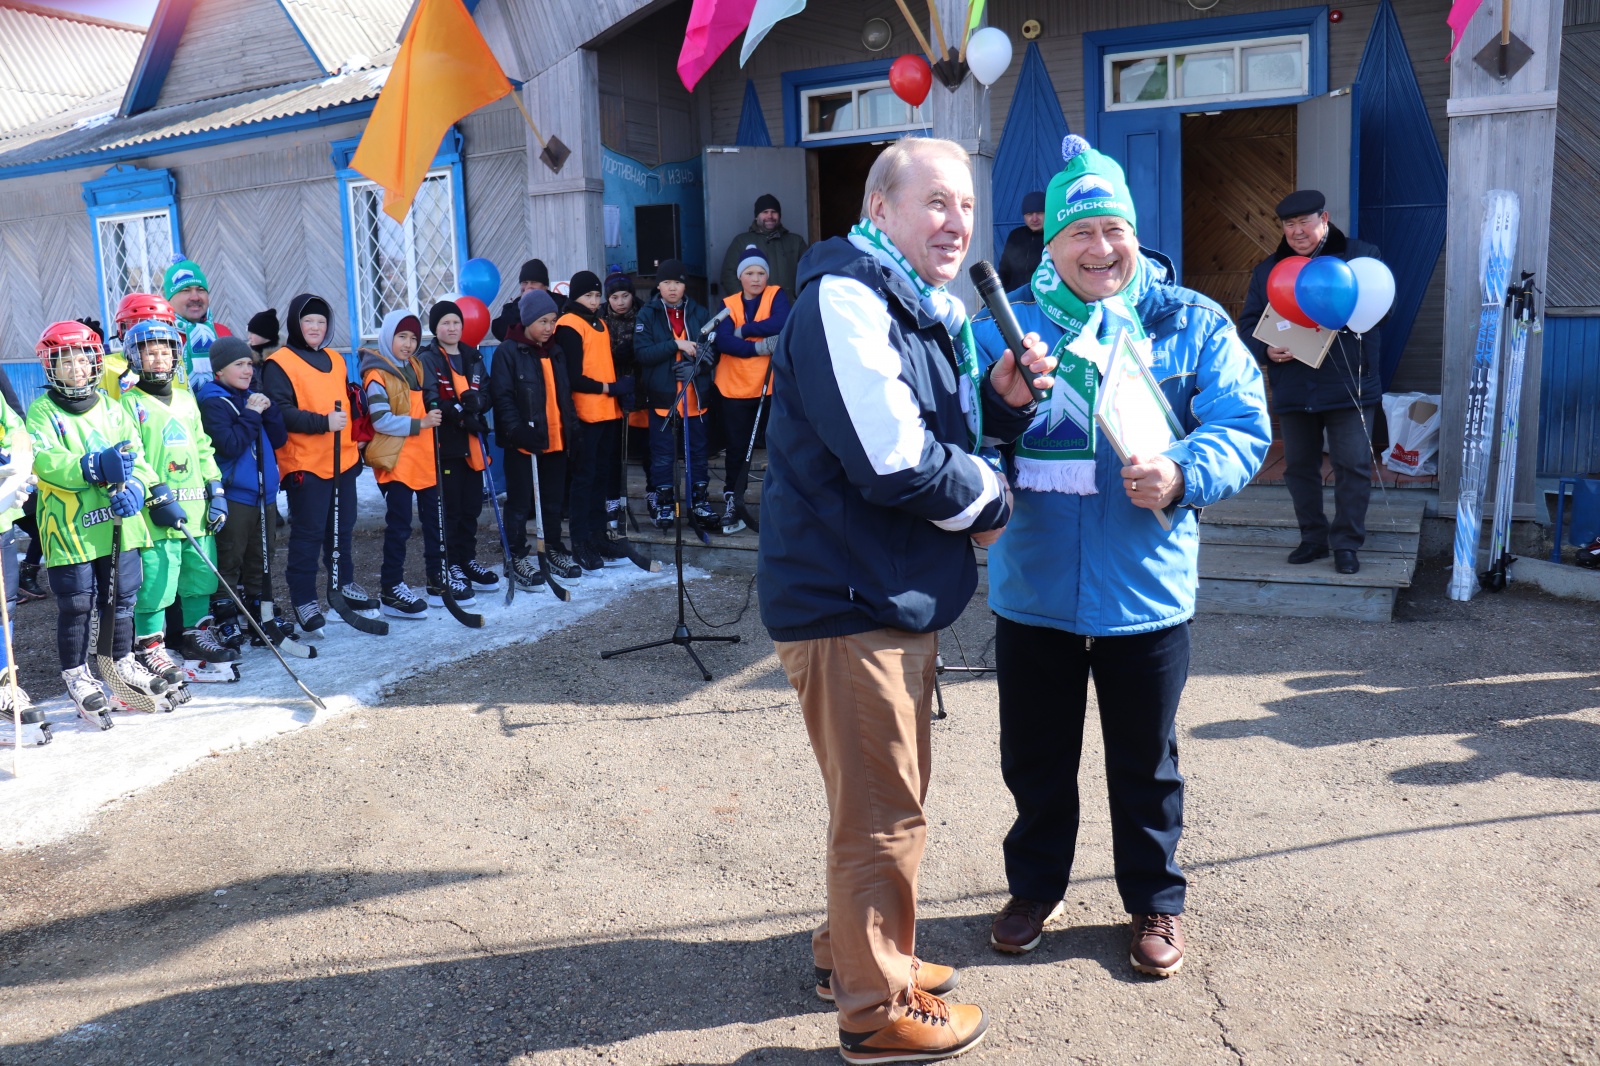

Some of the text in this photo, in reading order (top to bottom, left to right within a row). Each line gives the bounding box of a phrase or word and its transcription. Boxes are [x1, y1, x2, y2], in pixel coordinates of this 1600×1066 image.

[601, 155, 647, 188] ПОРТИВНАЯ
[1069, 317, 1086, 333] ОЛ
[1025, 435, 1086, 448] Сибскана
[145, 493, 168, 508] STEX
[107, 567, 116, 606] STEX
